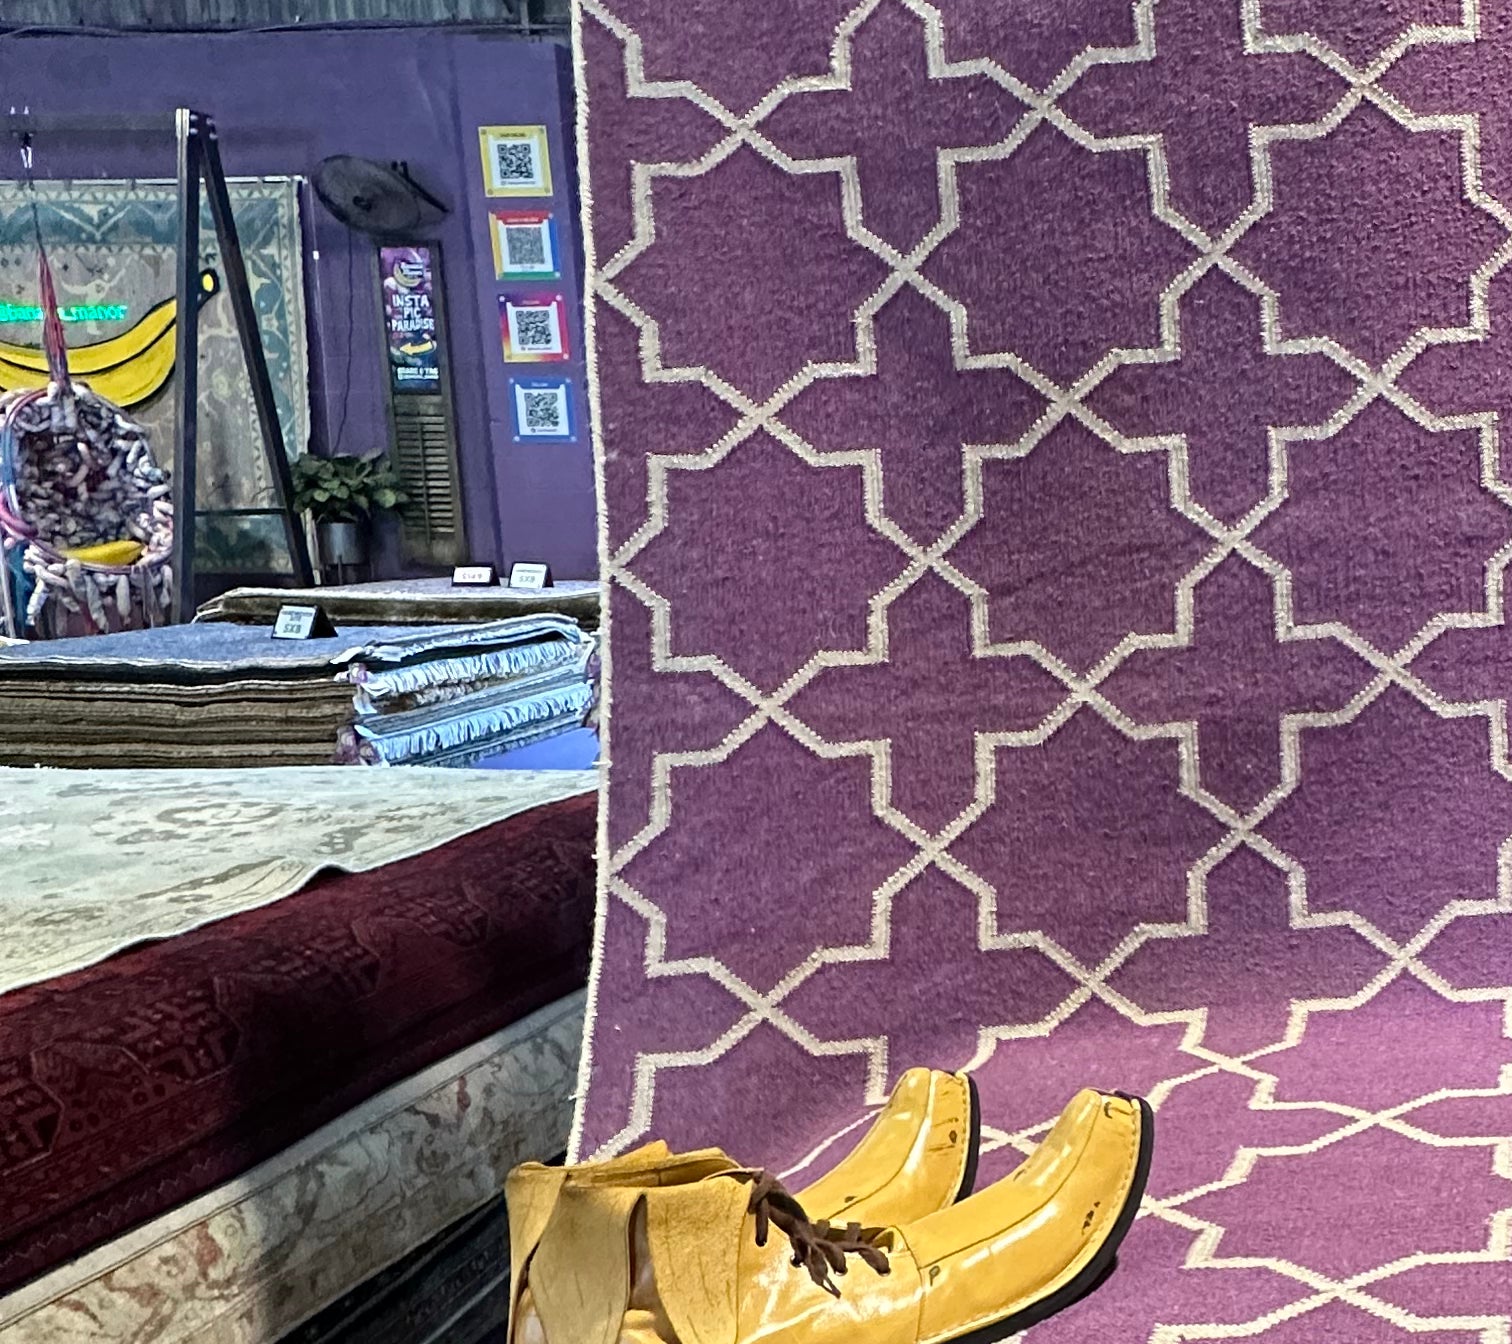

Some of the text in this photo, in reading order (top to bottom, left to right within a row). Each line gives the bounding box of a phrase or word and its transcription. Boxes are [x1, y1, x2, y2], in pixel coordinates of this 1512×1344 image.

[392, 294, 430, 307] INSTA
[0, 303, 128, 322] @bana_manor
[403, 307, 421, 319] PIC
[391, 318, 435, 332] PARADISE
